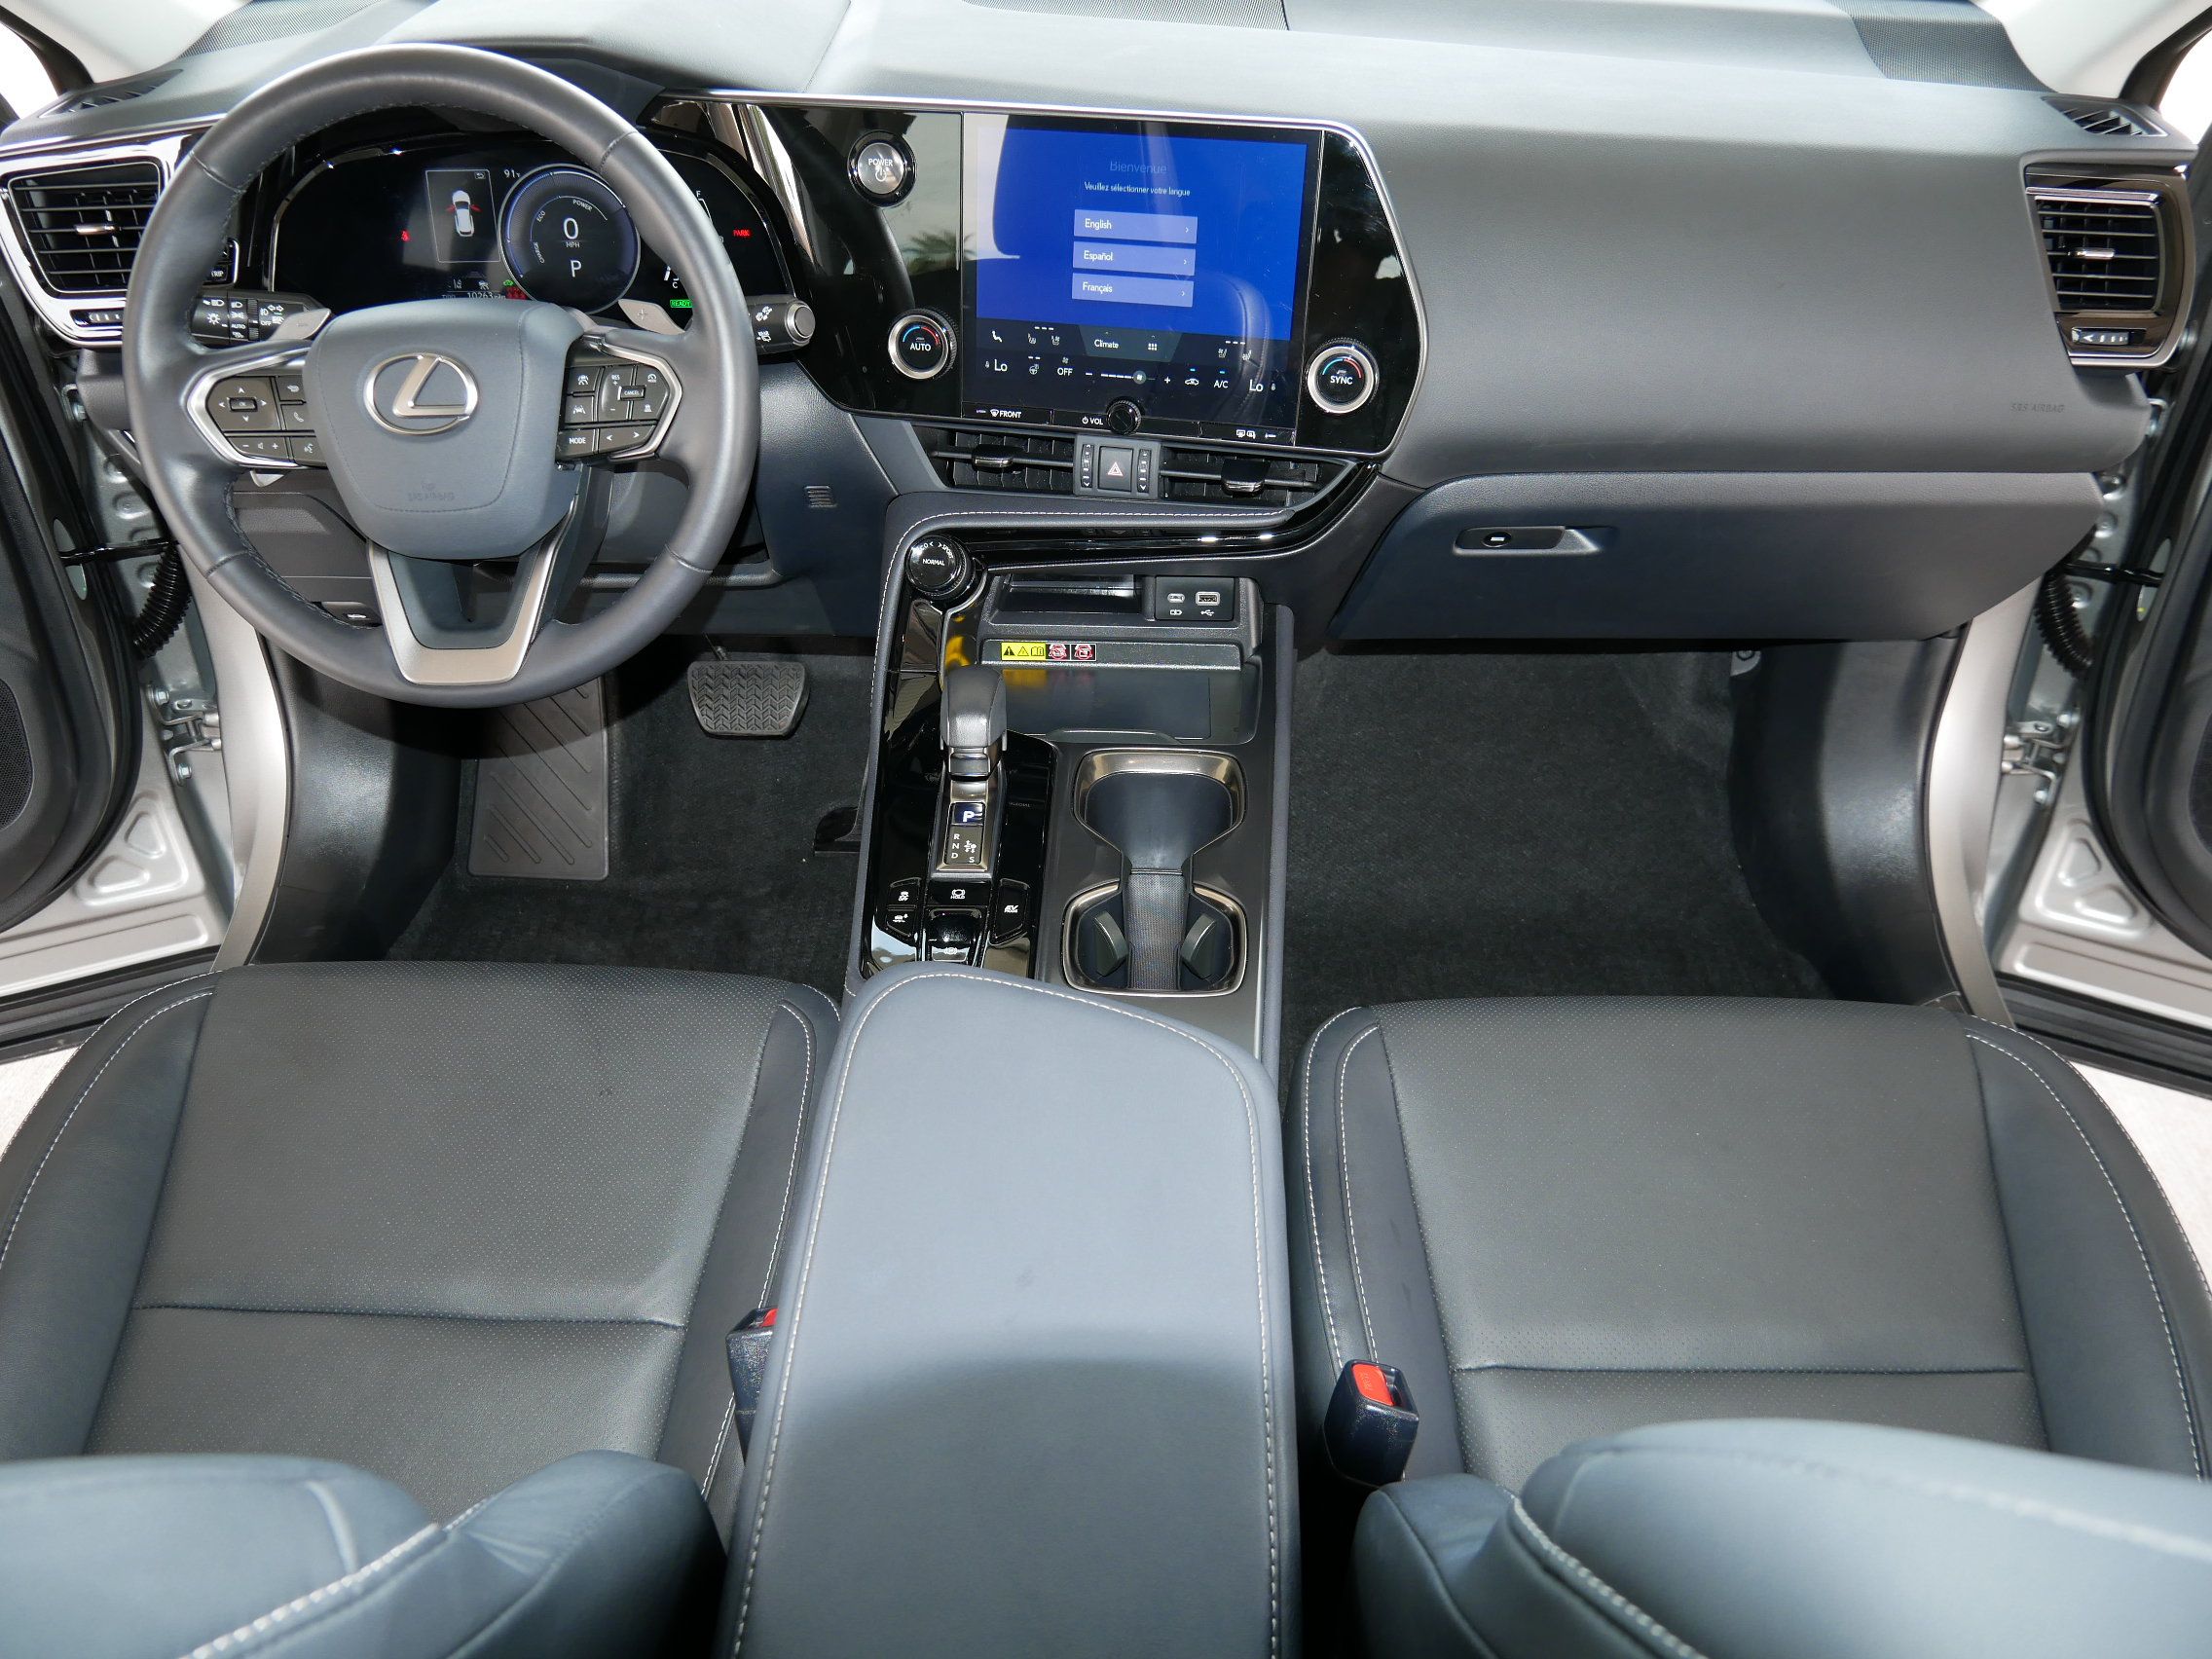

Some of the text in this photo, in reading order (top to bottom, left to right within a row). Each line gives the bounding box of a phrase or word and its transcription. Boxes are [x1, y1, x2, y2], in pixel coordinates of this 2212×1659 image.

[867, 158, 893, 166] POWER
[1110, 161, 1168, 174] Bienvenue
[1084, 182, 1191, 197] Veuillez sélectionner votre langue
[572, 199, 593, 211] POWER
[536, 210, 545, 222] ECO
[563, 217, 579, 240] 0
[1085, 218, 1112, 230] English
[1084, 250, 1113, 262] Español
[571, 259, 582, 277] P
[1082, 281, 1113, 294] Français
[909, 342, 932, 351] AUTO
[1093, 339, 1120, 349] Climate
[994, 358, 1008, 372] Lo
[1056, 367, 1073, 377] OFF
[1213, 380, 1229, 388] A/C
[1249, 379, 1264, 392] Lo
[1330, 375, 1353, 386] SYNC
[999, 410, 1022, 419] FRONT
[1089, 417, 1104, 425] VOL
[922, 558, 945, 567] NORMAL
[962, 810, 975, 823] P
